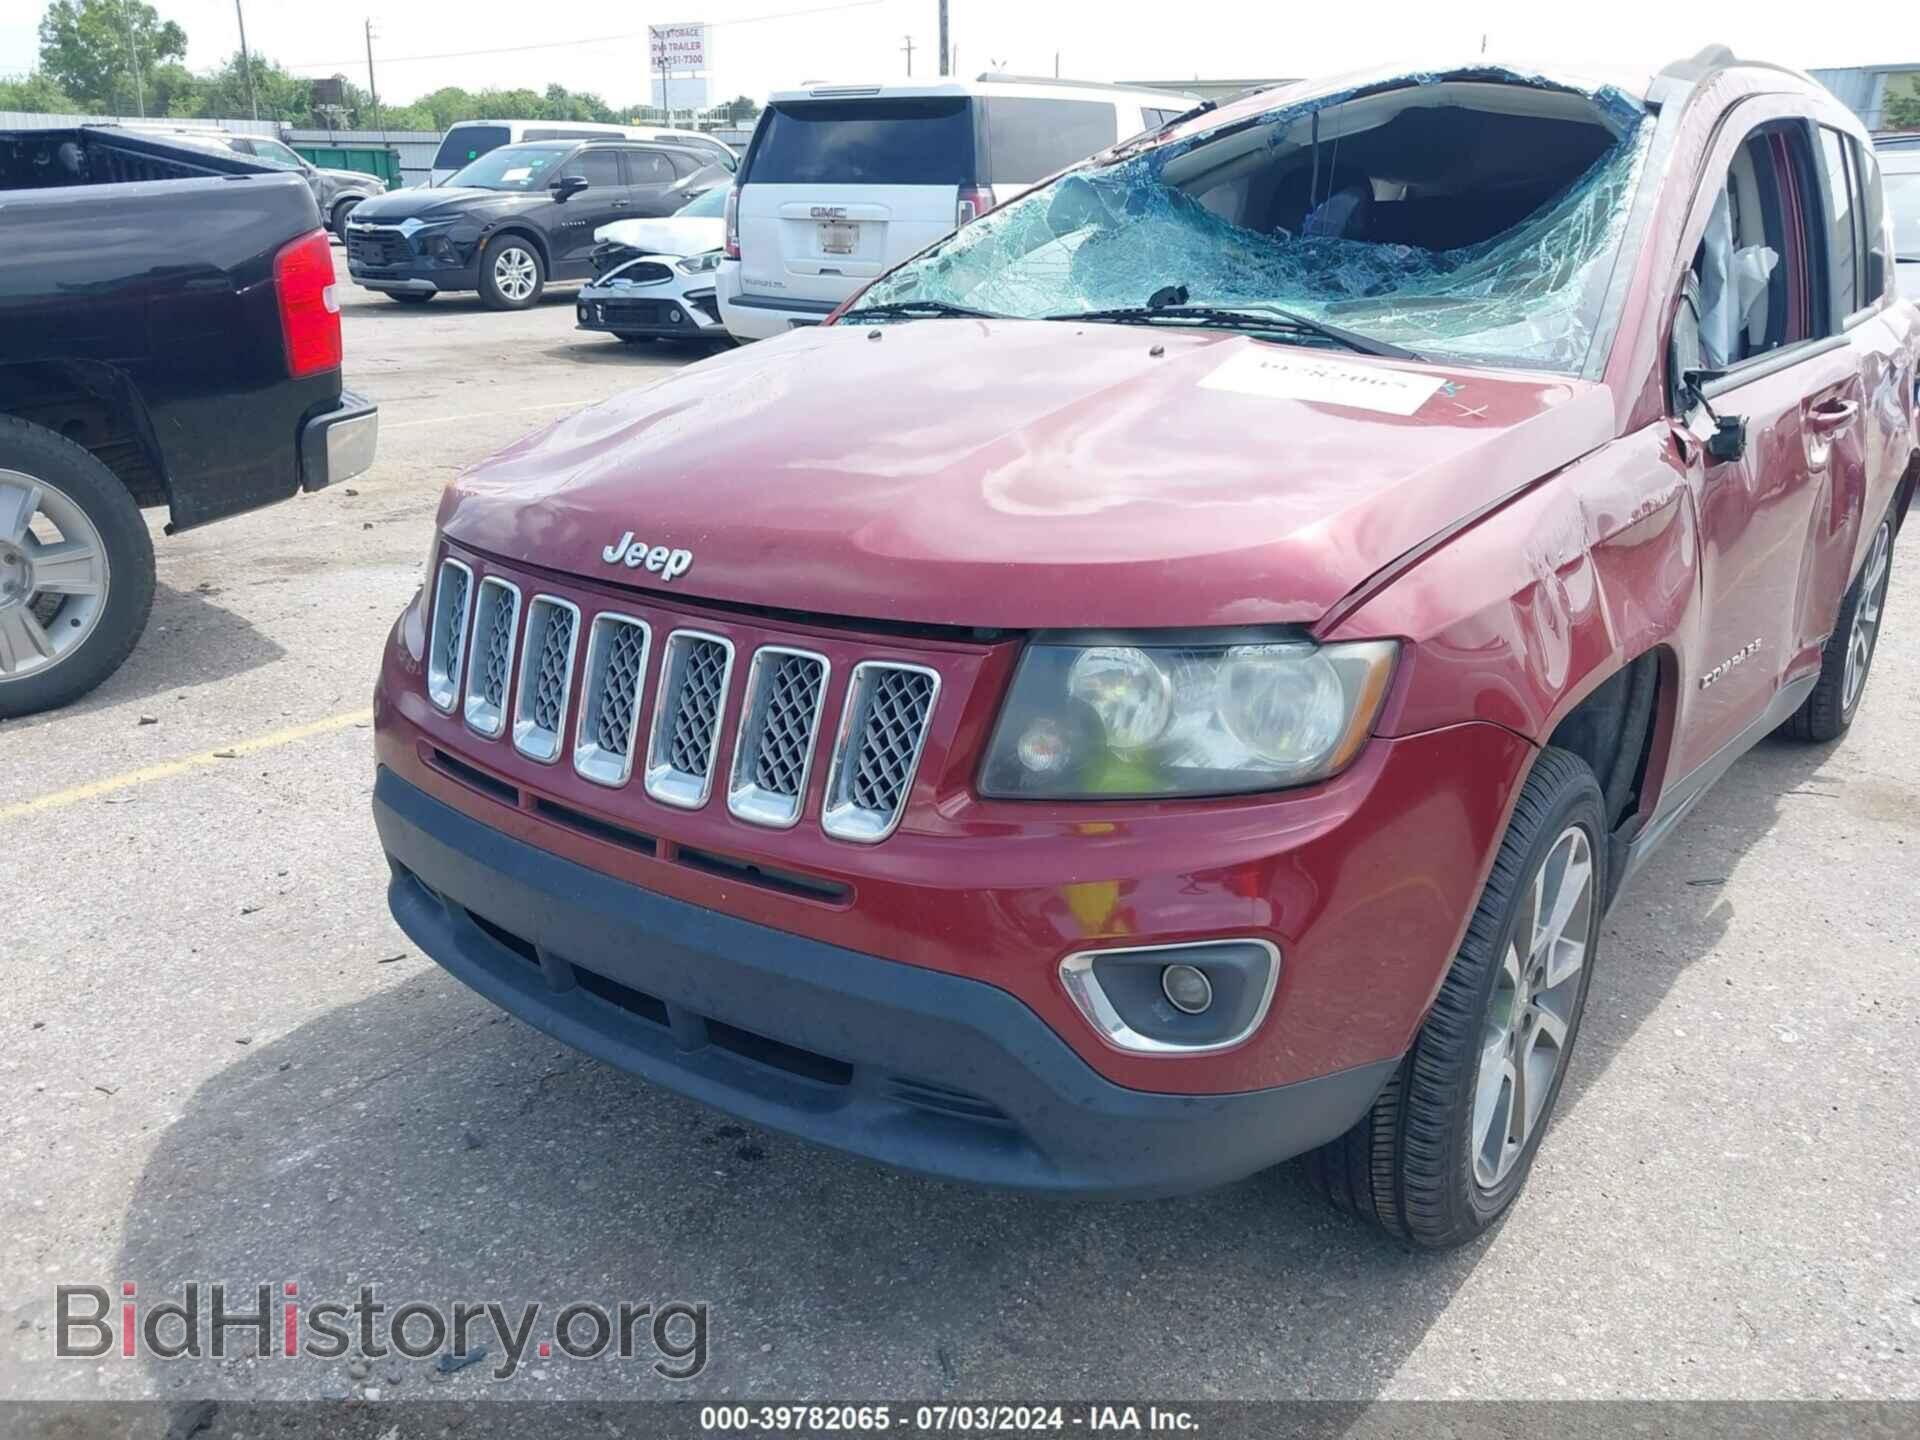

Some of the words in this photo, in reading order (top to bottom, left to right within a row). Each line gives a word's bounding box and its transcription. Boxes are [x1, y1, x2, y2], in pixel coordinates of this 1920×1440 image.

[668, 41, 701, 51] TRAILER
[810, 207, 847, 218] GMC
[602, 531, 693, 582] Jeep
